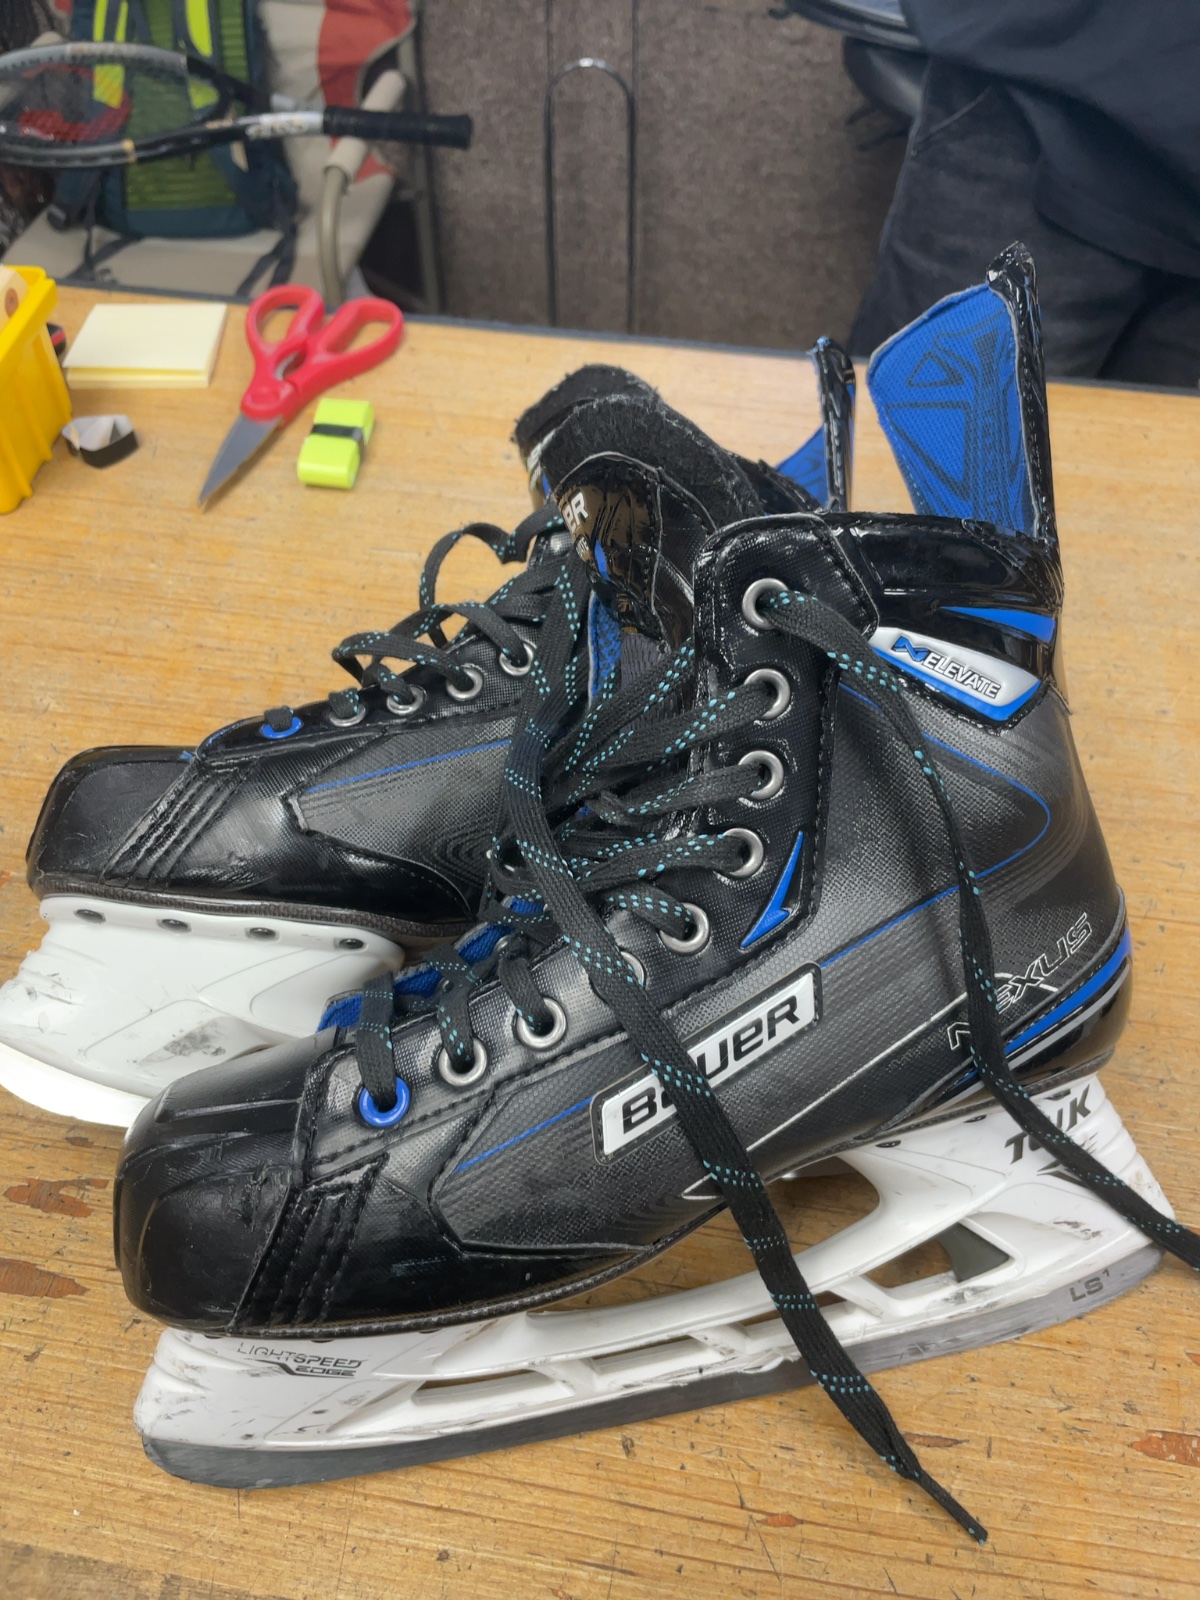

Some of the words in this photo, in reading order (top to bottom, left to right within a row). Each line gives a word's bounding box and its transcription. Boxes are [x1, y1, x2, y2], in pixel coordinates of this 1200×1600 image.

[922, 651, 1002, 700] ELEVATE
[237, 1342, 364, 1369] LIGHTSPEED
[295, 1365, 357, 1377] EDGE
